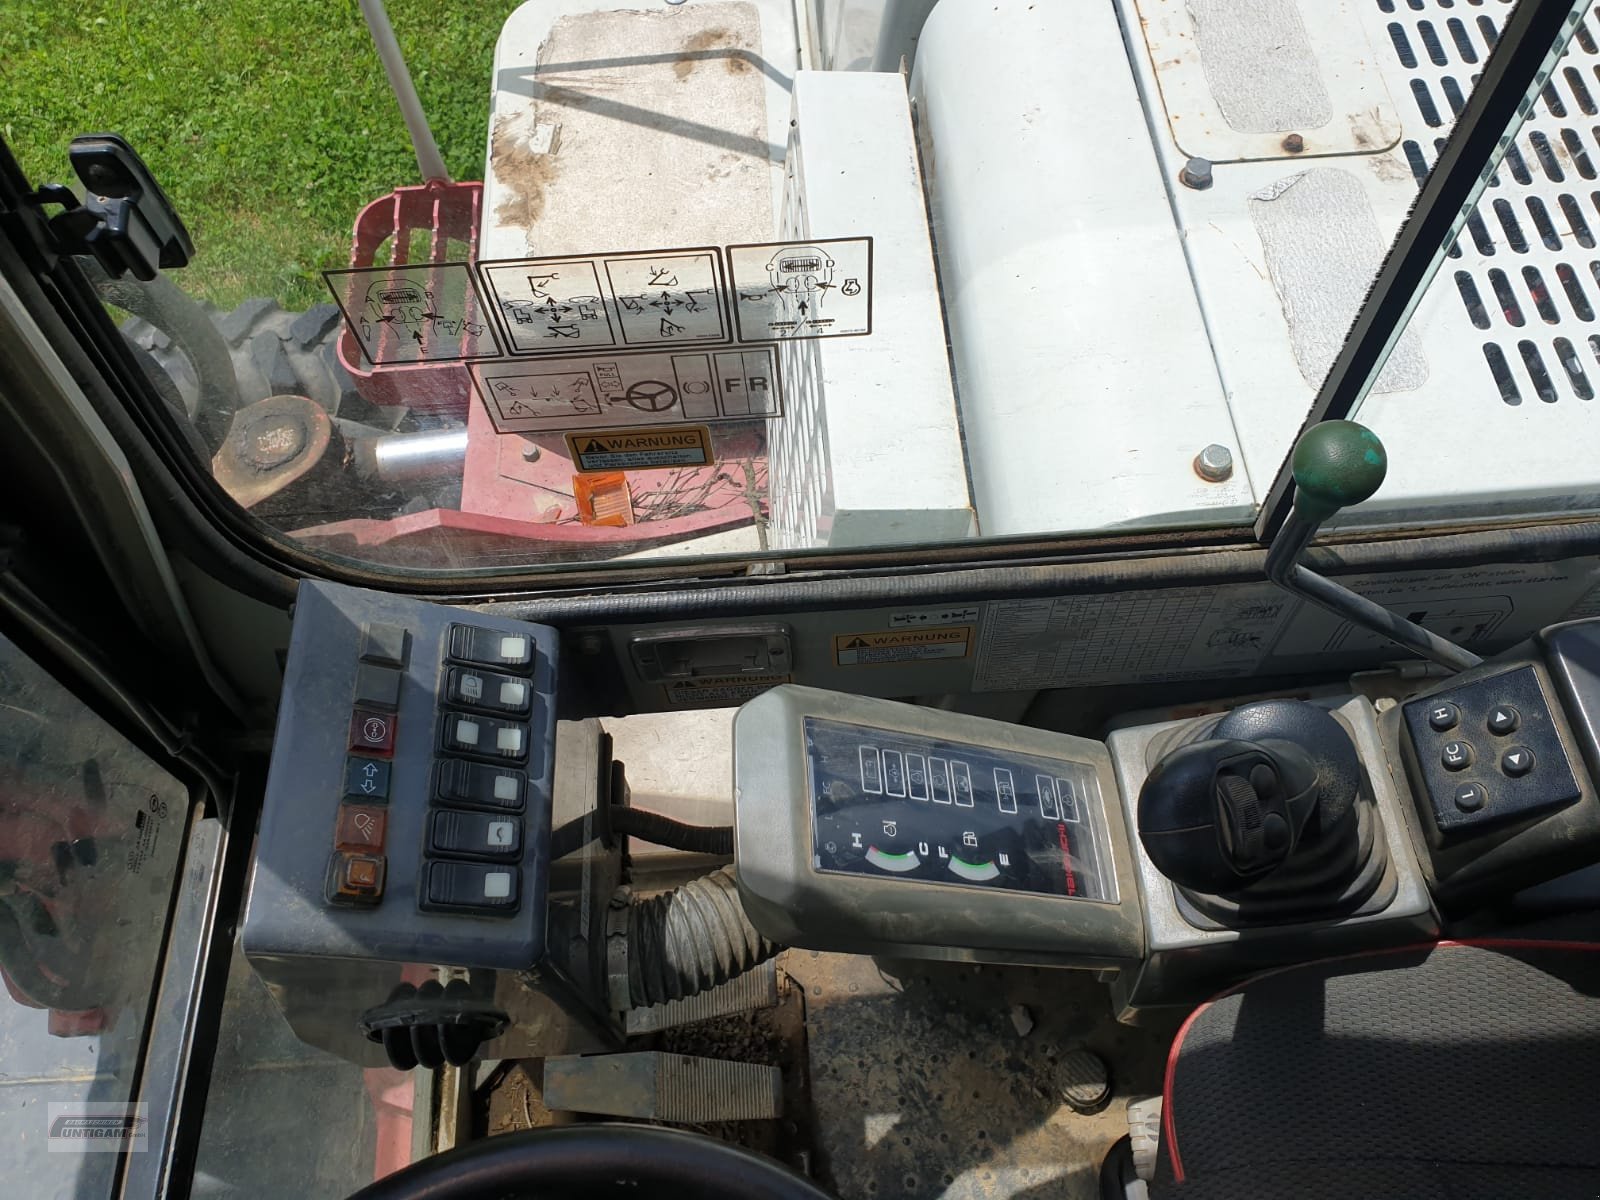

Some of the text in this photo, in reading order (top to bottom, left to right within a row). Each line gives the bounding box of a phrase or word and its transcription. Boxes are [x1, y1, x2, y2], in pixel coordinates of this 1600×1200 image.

[725, 378, 741, 393] F
[748, 377, 768, 392] R
[608, 435, 696, 449] WARNUNG
[873, 630, 962, 645] WARNUNG
[1434, 707, 1448, 720] H
[851, 832, 863, 849] H
[918, 841, 929, 856] C
[938, 845, 949, 859] F
[999, 852, 1011, 866] E
